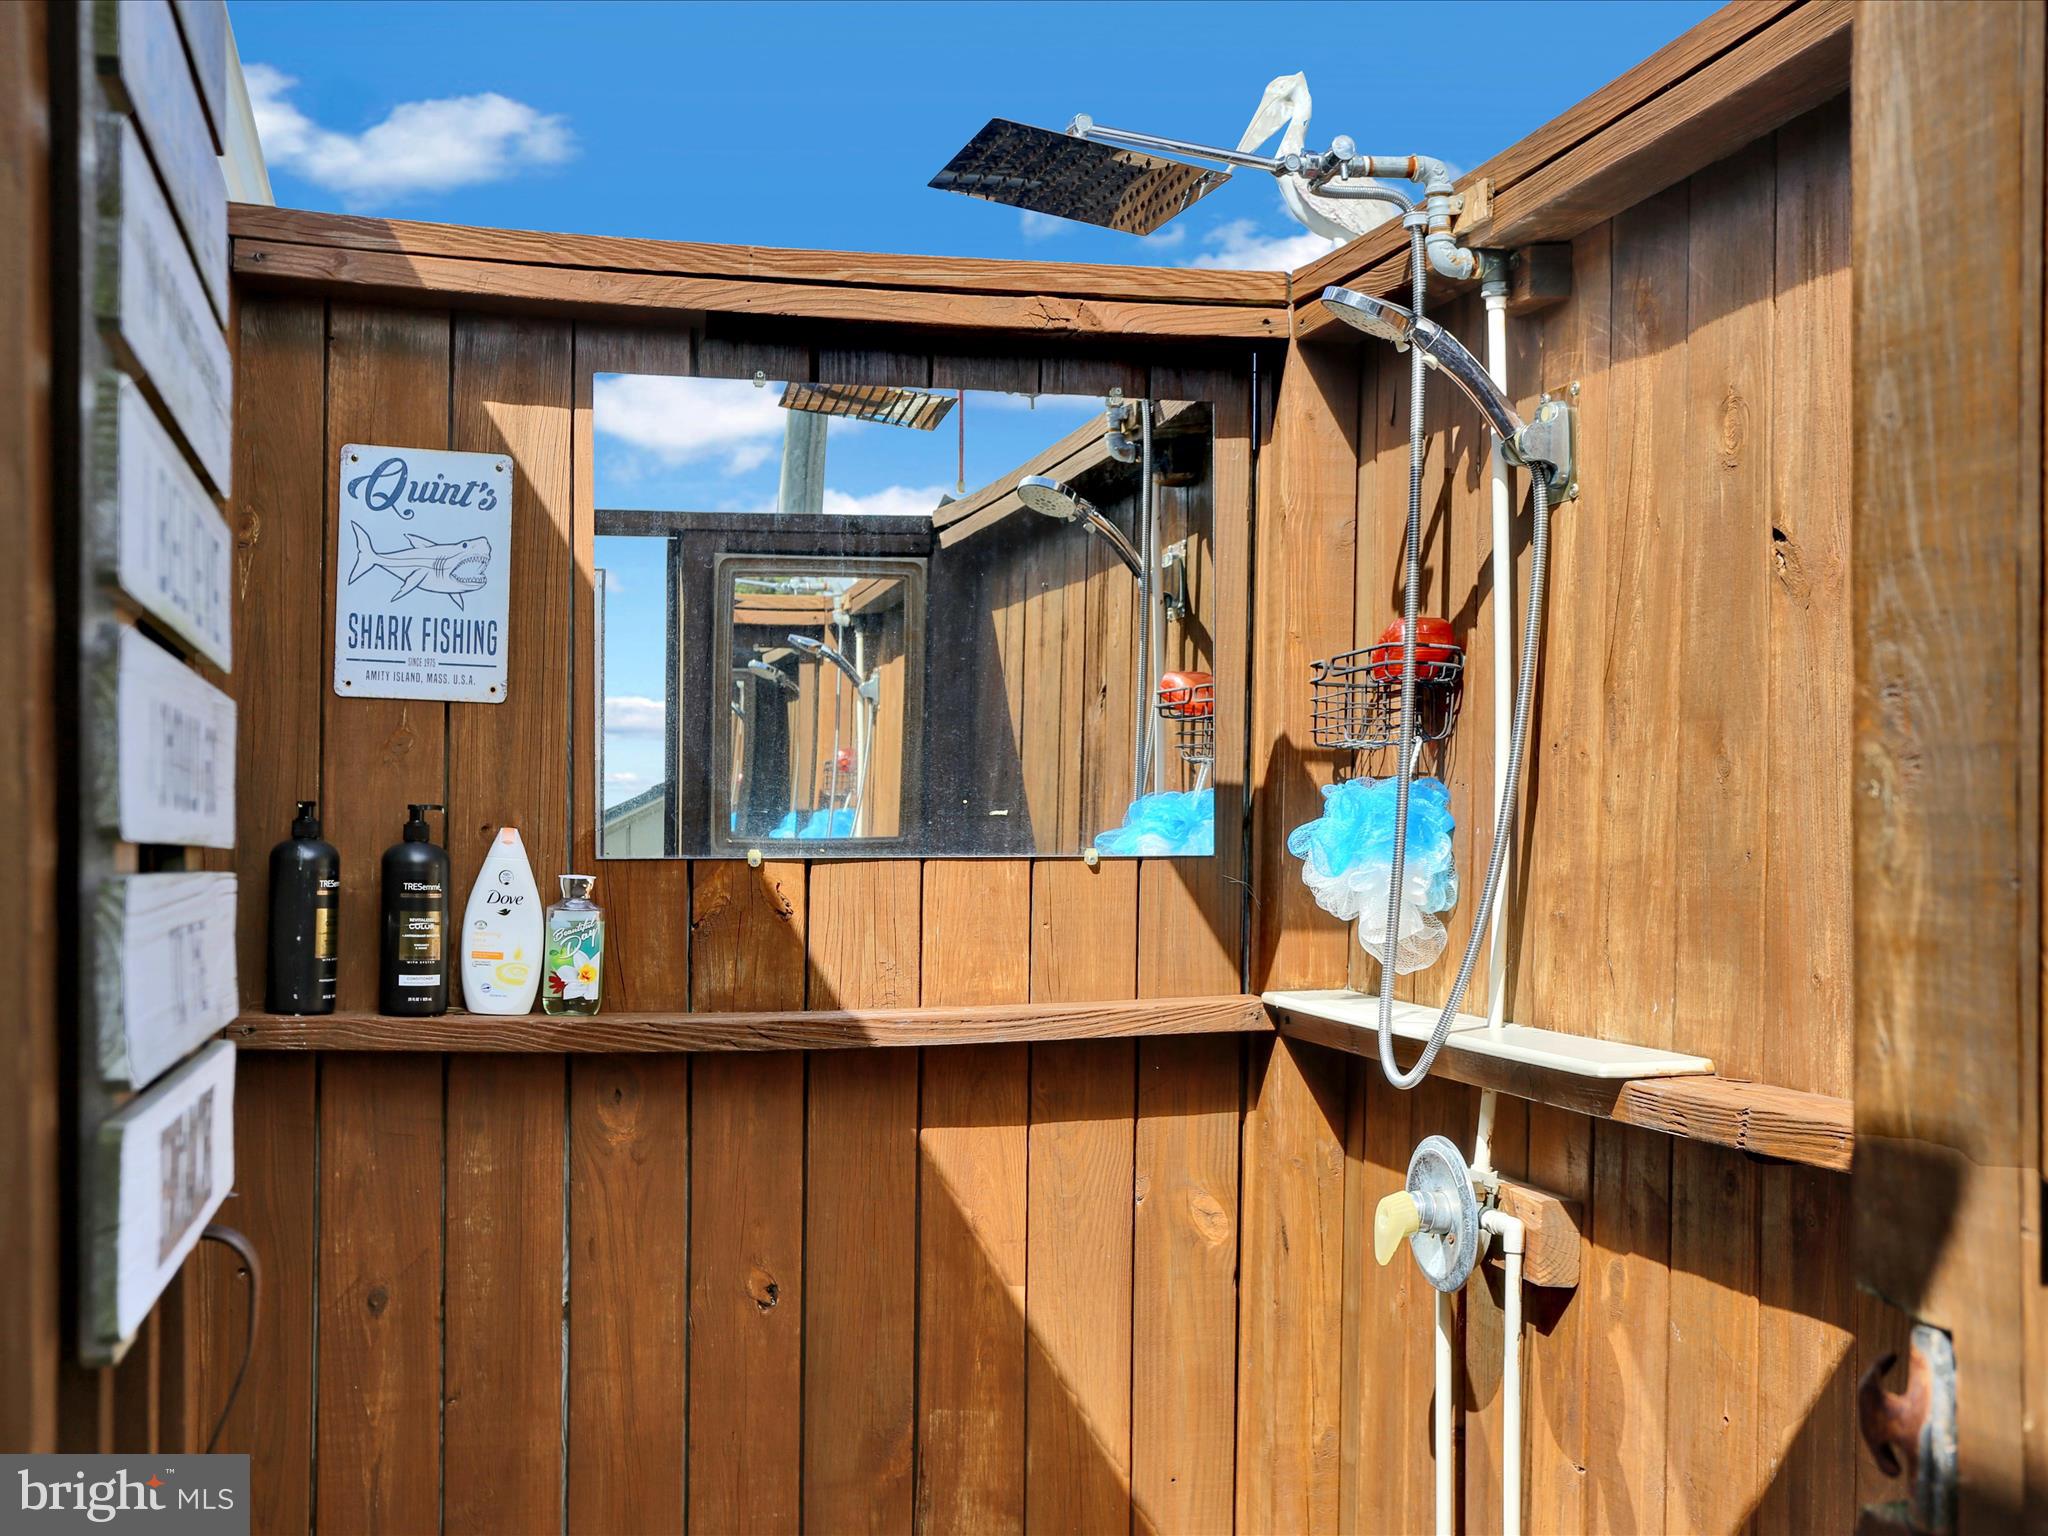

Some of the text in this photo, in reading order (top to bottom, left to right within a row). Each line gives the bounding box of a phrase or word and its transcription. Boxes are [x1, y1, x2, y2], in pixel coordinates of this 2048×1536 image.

[348, 457, 497, 520] Quint's
[348, 612, 498, 656] SHARK FISHING
[408, 657, 436, 668] SINCE 1975
[365, 670, 476, 686] AMITY ISLAND, MASS. U.S.A.
[487, 889, 524, 905] Dove
[553, 919, 594, 941] Beautiful
[560, 928, 598, 959] Day
